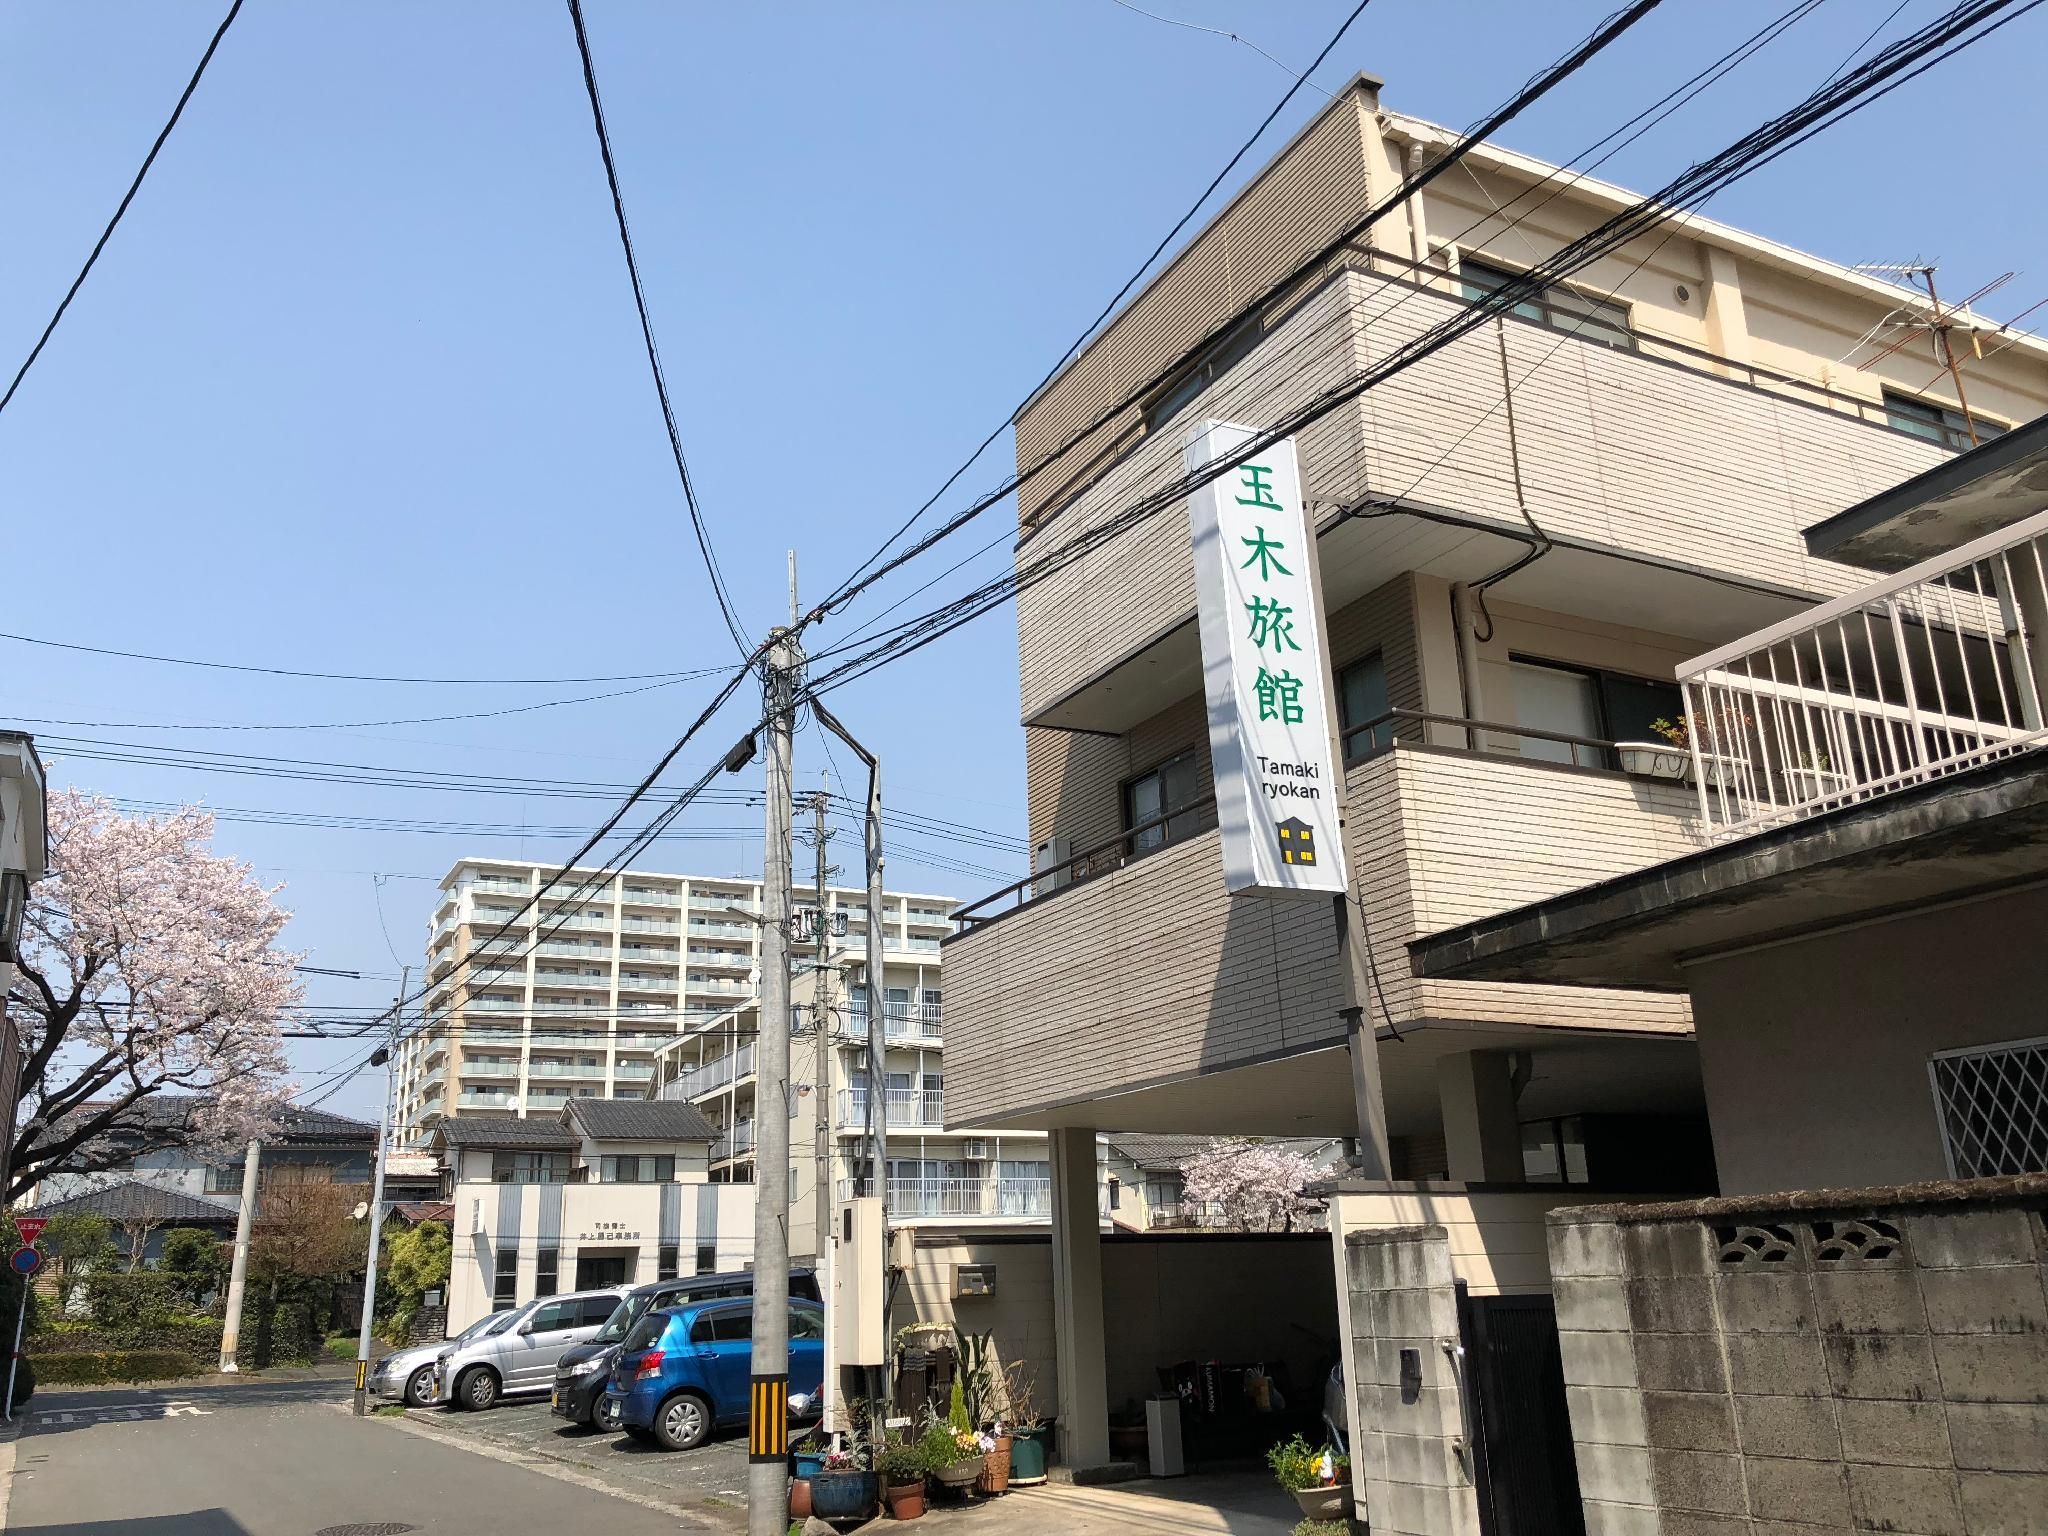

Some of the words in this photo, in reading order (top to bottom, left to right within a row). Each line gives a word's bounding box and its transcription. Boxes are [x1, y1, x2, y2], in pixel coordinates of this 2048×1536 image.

[1235, 464, 1304, 726] 玉木旅館
[1257, 756, 1319, 779] Tamaki
[1262, 781, 1320, 800] ryokan
